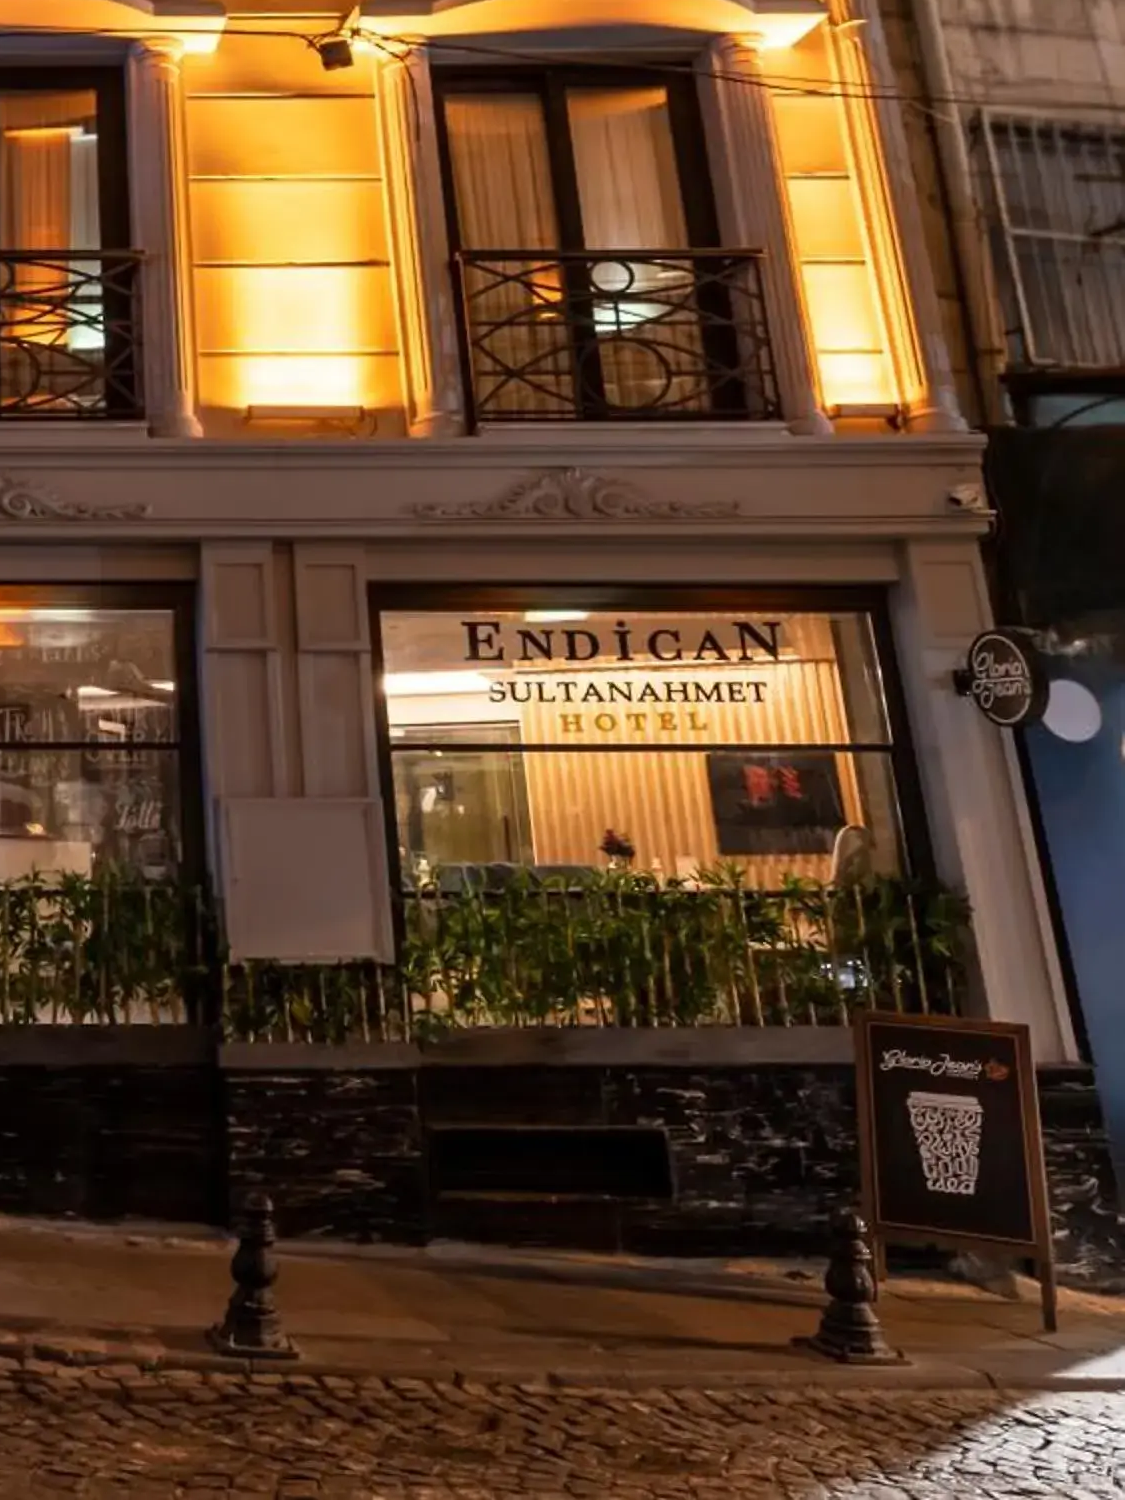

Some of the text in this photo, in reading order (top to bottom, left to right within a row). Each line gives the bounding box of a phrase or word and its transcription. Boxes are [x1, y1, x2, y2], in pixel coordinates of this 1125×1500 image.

[976, 651, 1024, 679] Gloria
[488, 680, 768, 703] SULTANAHMET
[560, 711, 709, 733] HOTEL
